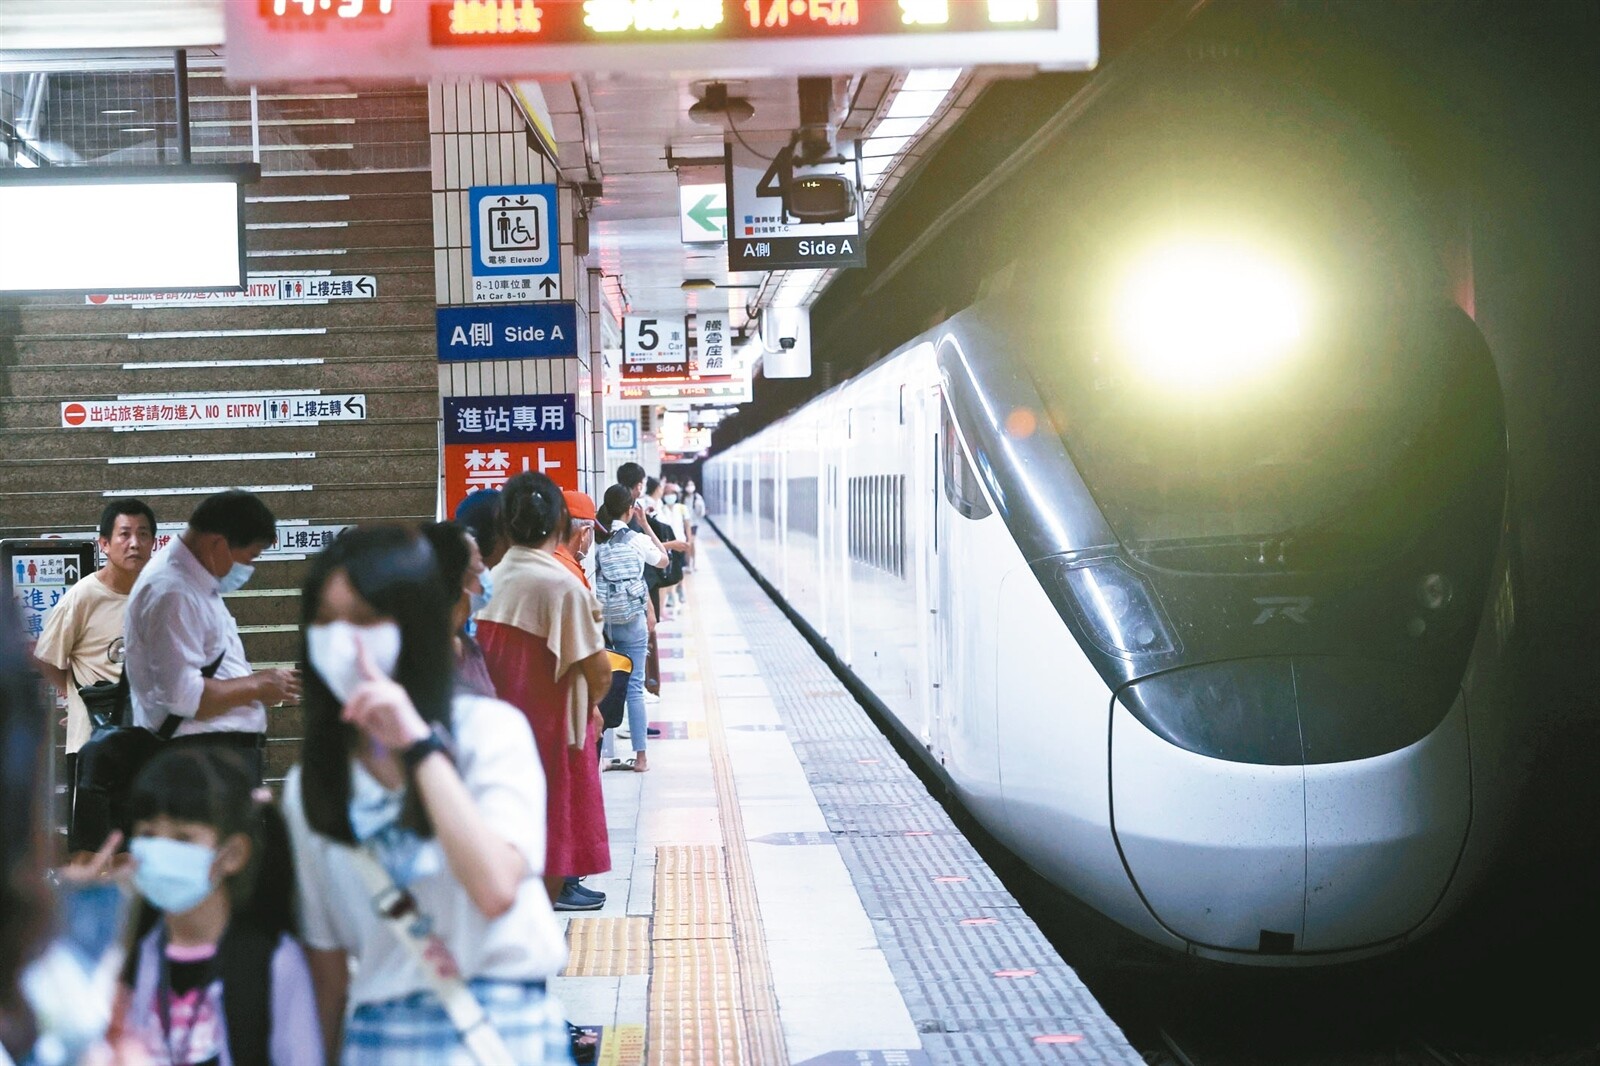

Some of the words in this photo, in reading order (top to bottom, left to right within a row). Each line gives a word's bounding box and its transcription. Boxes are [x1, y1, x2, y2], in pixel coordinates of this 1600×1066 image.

[743, 242, 770, 257] A側
[798, 240, 836, 255] Side
[840, 239, 853, 254] A
[488, 256, 506, 264] 電梯
[306, 280, 353, 297] 上樓左轉
[450, 322, 493, 347] A側
[504, 326, 545, 342] Side
[550, 325, 564, 340] A
[638, 319, 659, 351] 5
[671, 331, 680, 341] 車
[656, 364, 675, 373] Side
[676, 364, 683, 372] A
[90, 404, 202, 422] 出站旅客請勿進入
[205, 404, 220, 419] NO
[226, 403, 262, 418] ENTRY
[293, 400, 342, 417] 上樓左轉
[457, 405, 564, 432] 進站專用
